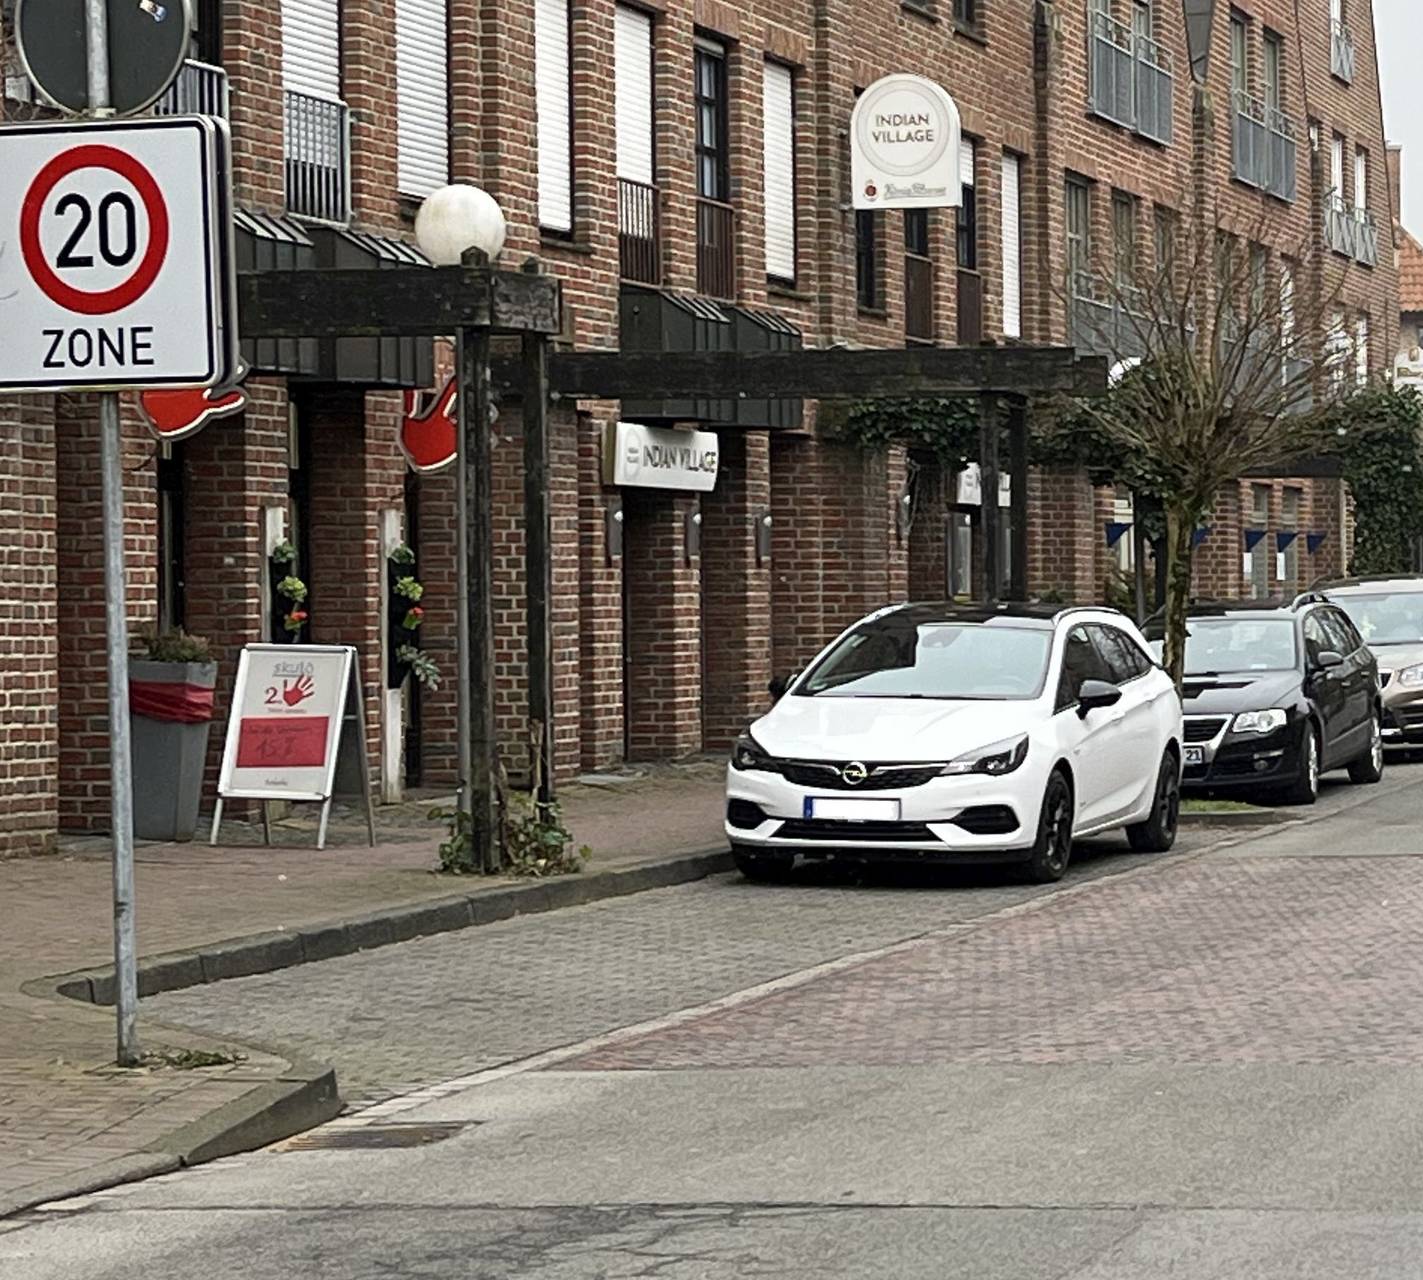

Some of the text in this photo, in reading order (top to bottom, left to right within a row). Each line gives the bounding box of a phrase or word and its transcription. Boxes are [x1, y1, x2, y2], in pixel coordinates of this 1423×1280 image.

[875, 113, 930, 127] INDIAN
[872, 129, 935, 143] VILLAGE
[54, 191, 137, 269] 20
[42, 326, 155, 368] ZONE
[642, 445, 677, 469] INDIAN
[679, 447, 717, 474] VILLAGE
[1186, 749, 1201, 761] 21
